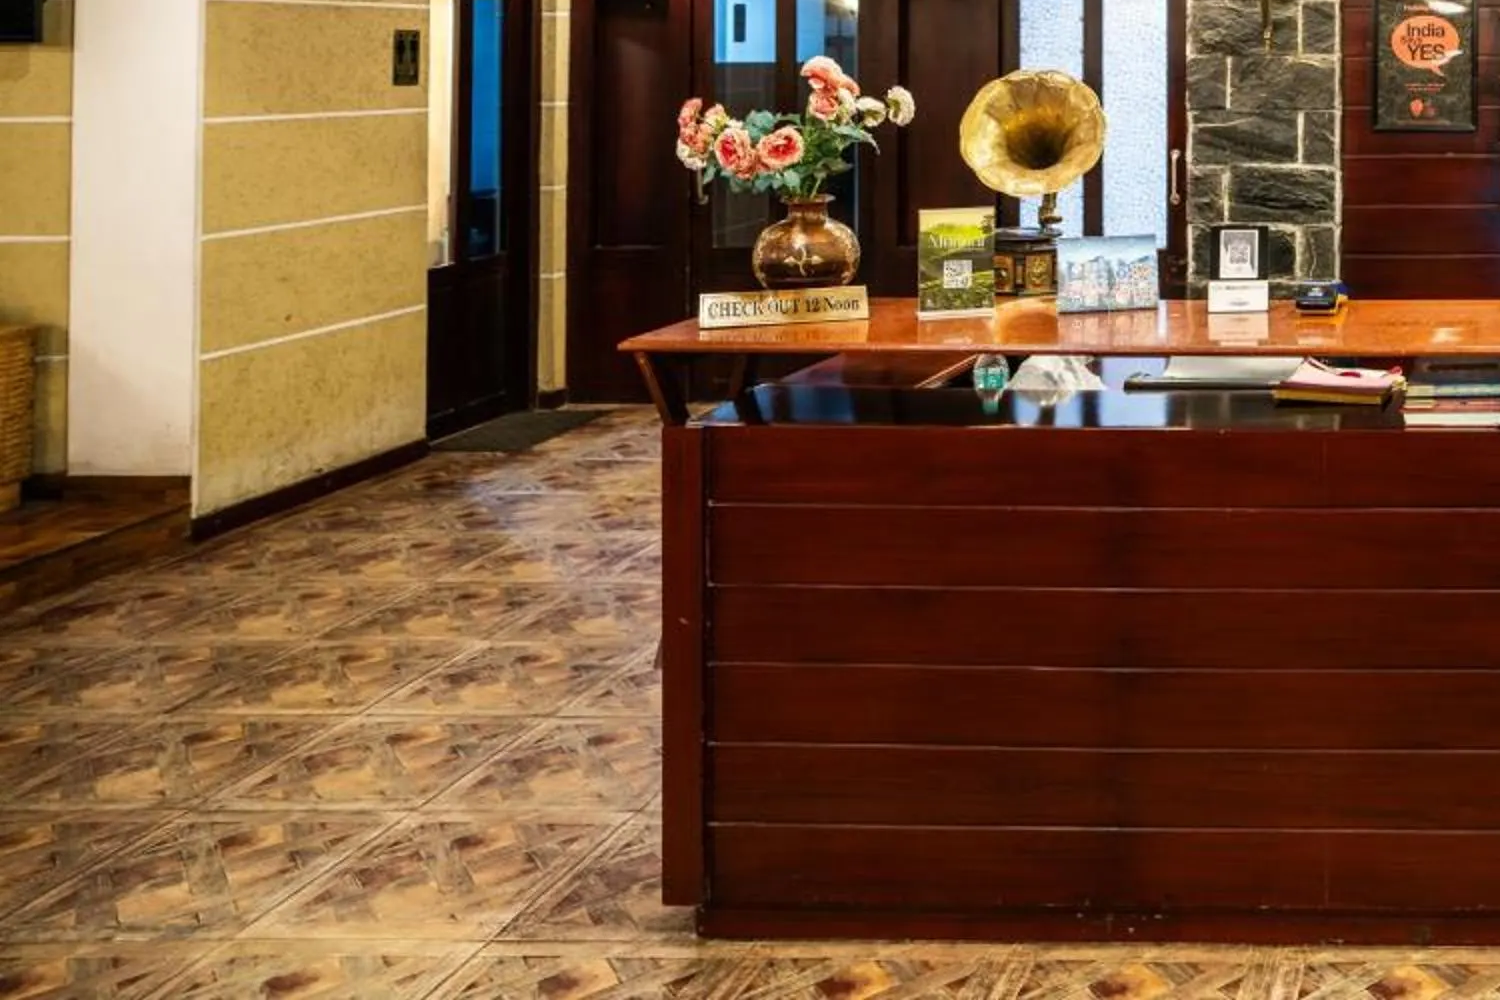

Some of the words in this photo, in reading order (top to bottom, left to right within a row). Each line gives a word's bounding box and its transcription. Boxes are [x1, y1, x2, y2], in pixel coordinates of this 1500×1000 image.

[1407, 23, 1446, 38] India
[1407, 43, 1446, 61] YES
[708, 300, 763, 319] CHECK
[767, 299, 801, 315] OUT
[805, 297, 821, 313] 12
[824, 297, 861, 312] Noon
